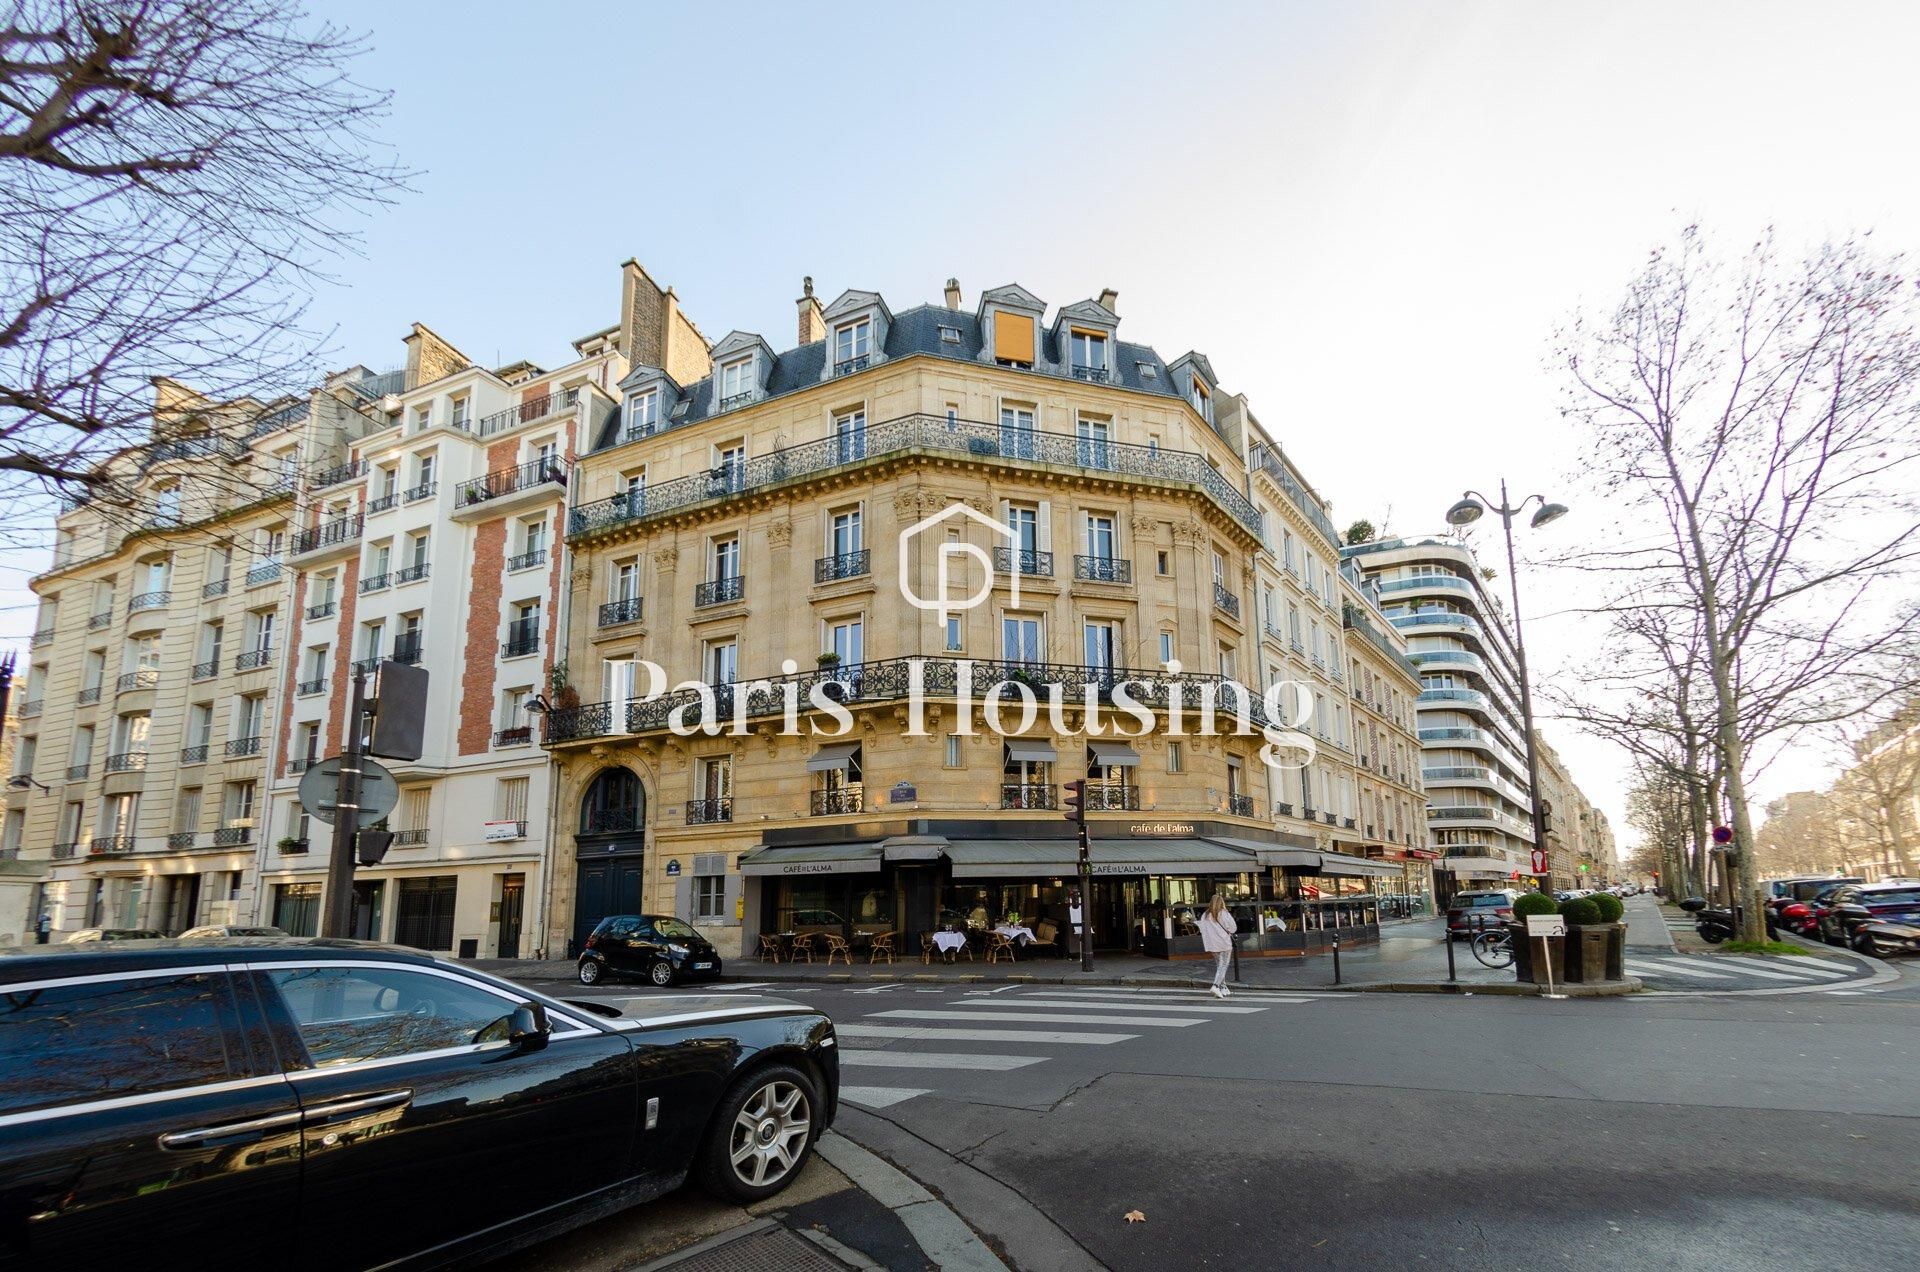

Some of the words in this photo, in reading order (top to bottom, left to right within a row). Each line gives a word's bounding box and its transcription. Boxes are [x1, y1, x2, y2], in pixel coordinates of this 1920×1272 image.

[1153, 823, 1166, 833] de
[806, 864, 833, 872] L'ALMA
[1091, 864, 1111, 873] CAFÉ
[1117, 865, 1147, 873] L'ALMA
